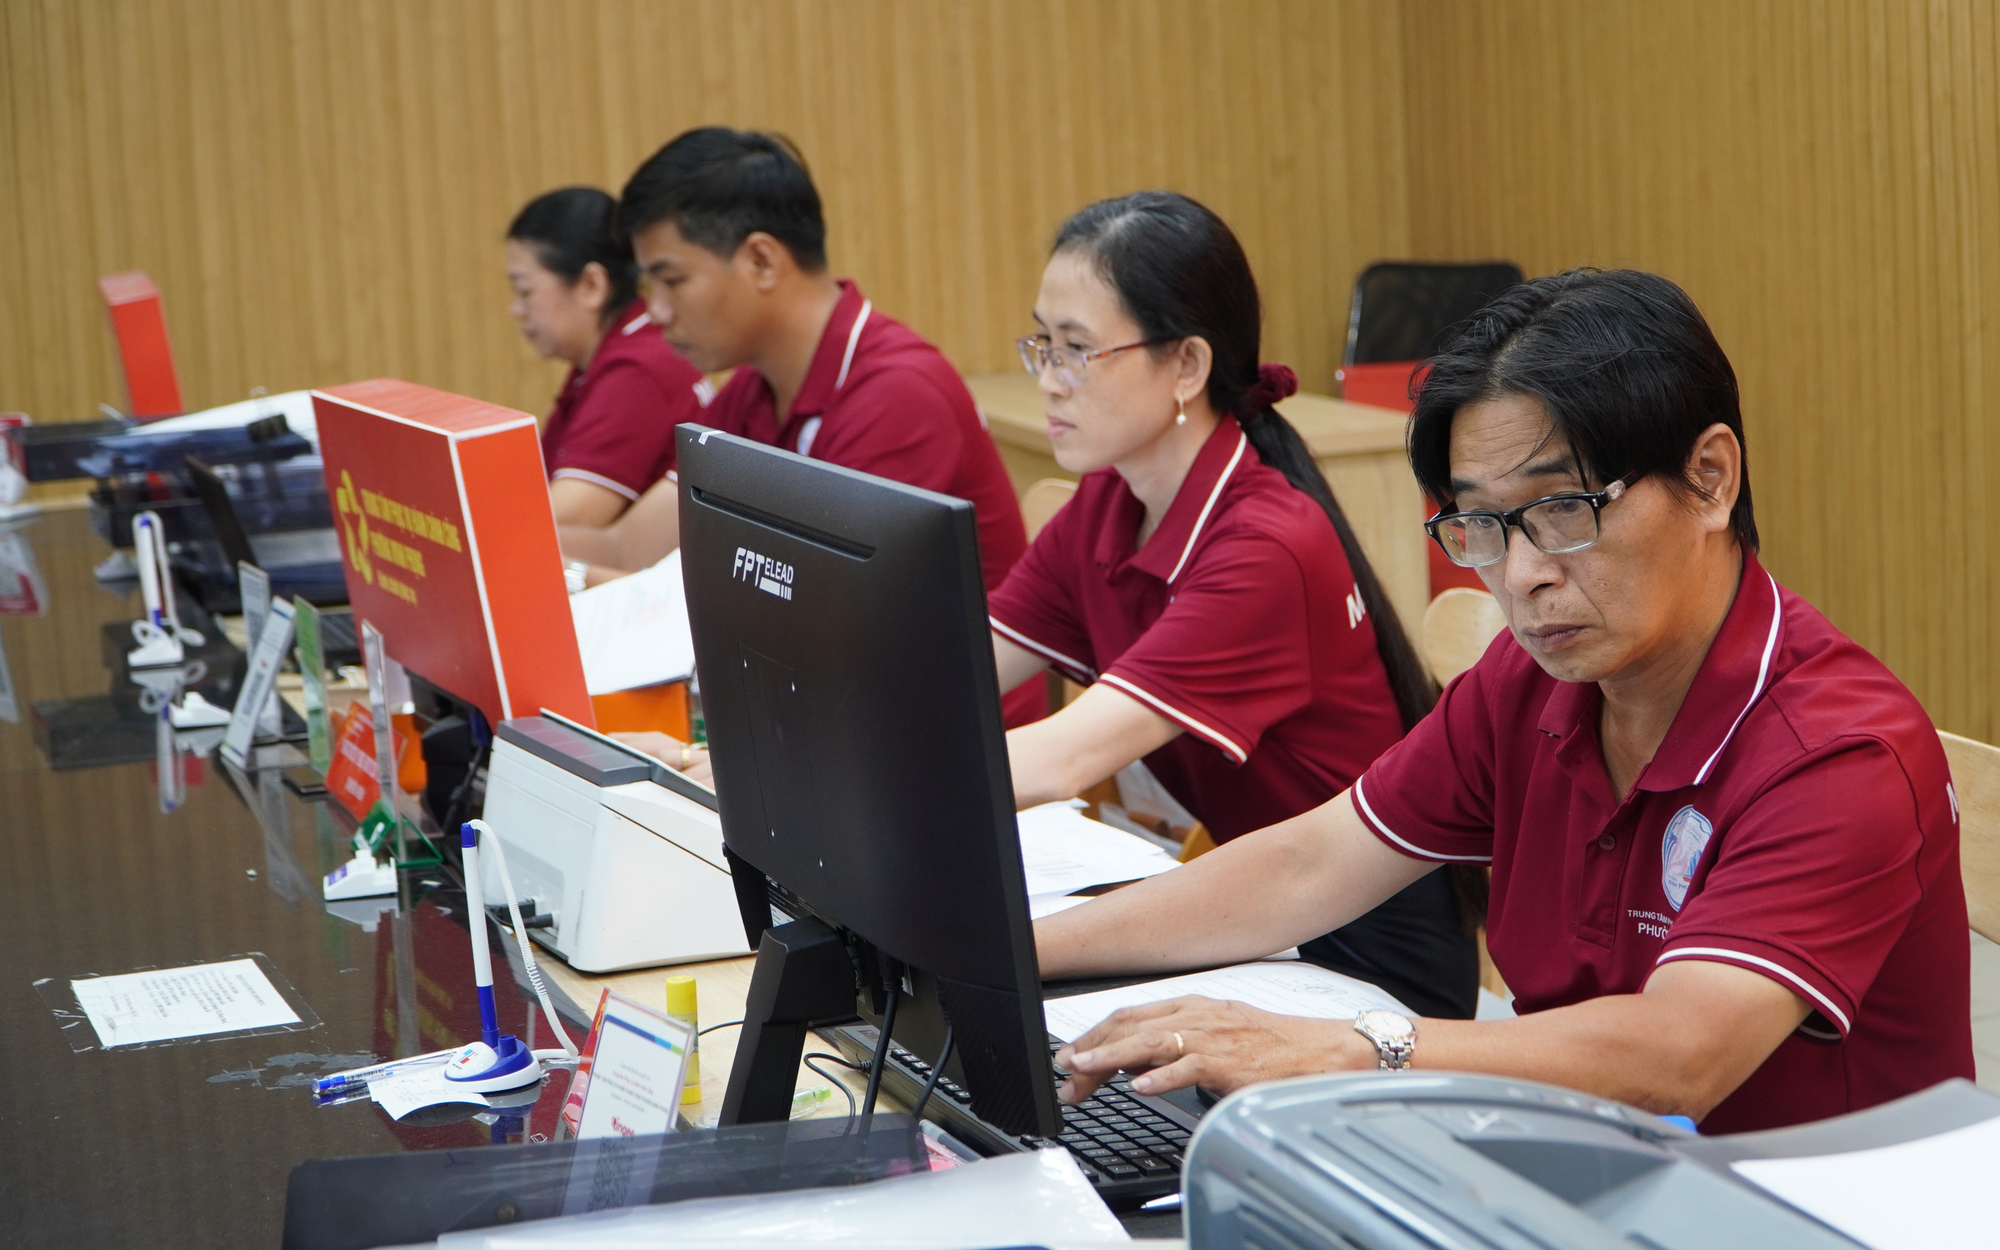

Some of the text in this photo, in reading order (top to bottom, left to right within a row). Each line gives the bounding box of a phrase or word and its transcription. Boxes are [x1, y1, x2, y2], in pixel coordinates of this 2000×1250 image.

[733, 547, 794, 587] FPT ELEAD
[1627, 909, 1656, 920] TRUNG
[1656, 912, 1668, 923] TÂM
